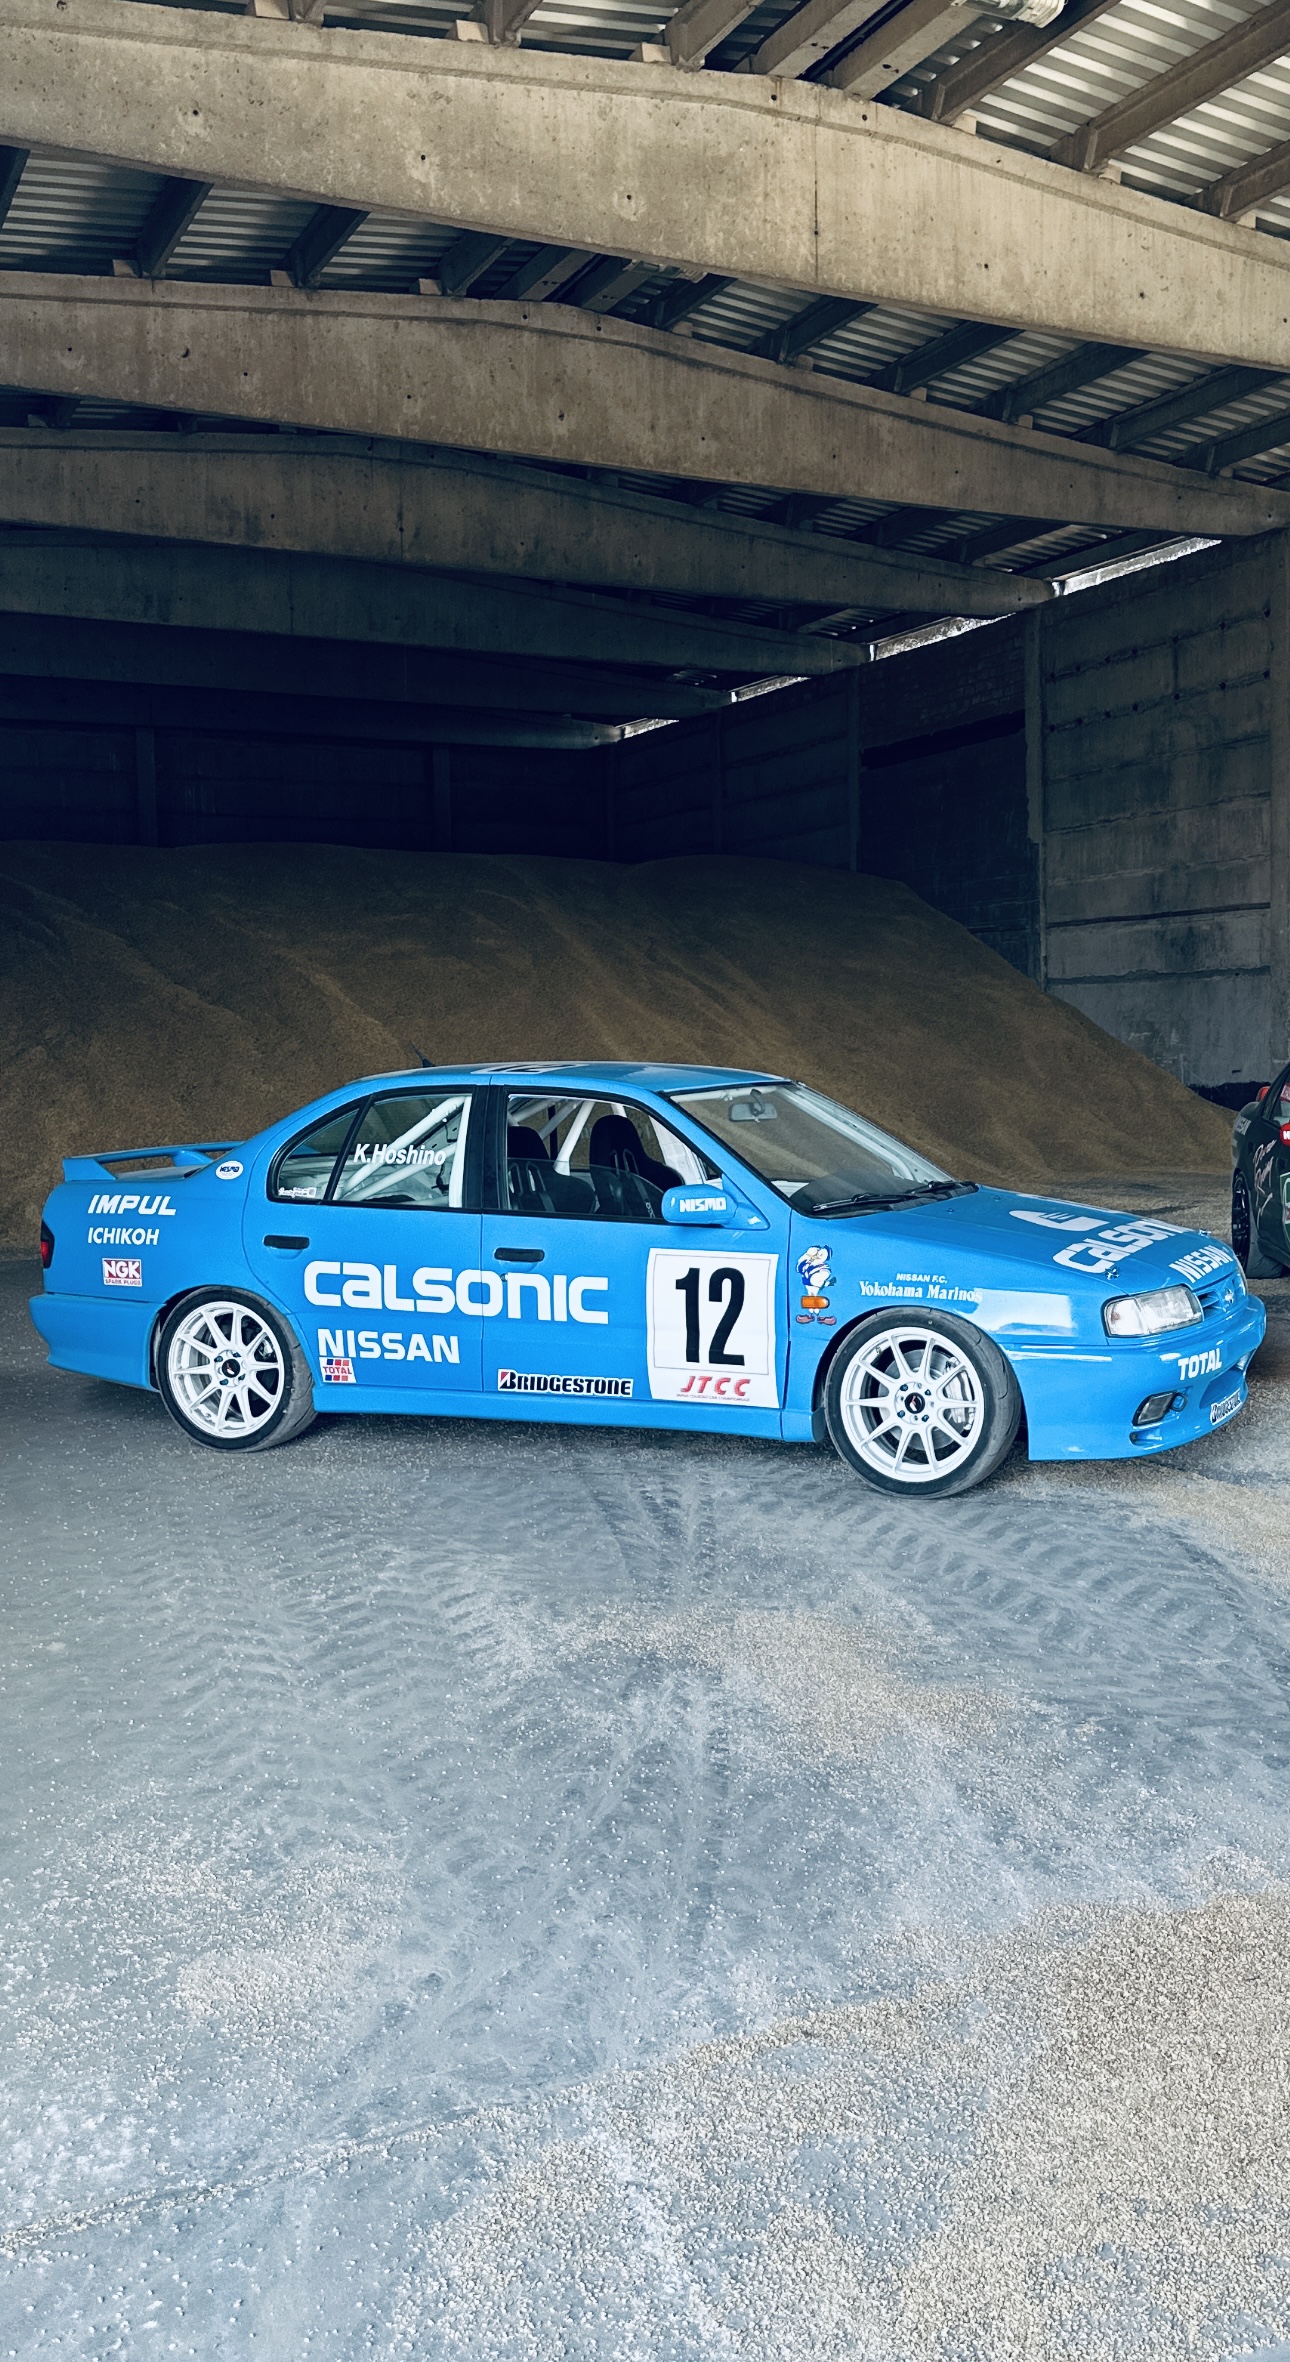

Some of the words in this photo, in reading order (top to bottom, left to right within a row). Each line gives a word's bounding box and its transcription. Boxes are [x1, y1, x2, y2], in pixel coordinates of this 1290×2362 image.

[353, 1143, 447, 1166] K.Hoshino
[87, 1194, 177, 1216] IMPUL
[679, 1197, 727, 1212] NISMO
[87, 1227, 160, 1245] ICHIKOH
[103, 1260, 140, 1279] NGK
[1168, 1244, 1234, 1284] NISSAN
[896, 1273, 930, 1283] NISSAN
[931, 1274, 948, 1284] F.C.
[859, 1280, 923, 1298] Yokohama
[926, 1284, 984, 1303] Marinos
[675, 1267, 745, 1366] 12
[317, 1328, 460, 1364] NISSAN
[322, 1366, 353, 1375] TOTAL
[1177, 1347, 1223, 1381] TOTAL
[499, 1370, 632, 1396] BRIDGESTONE
[680, 1376, 751, 1396] JTCC
